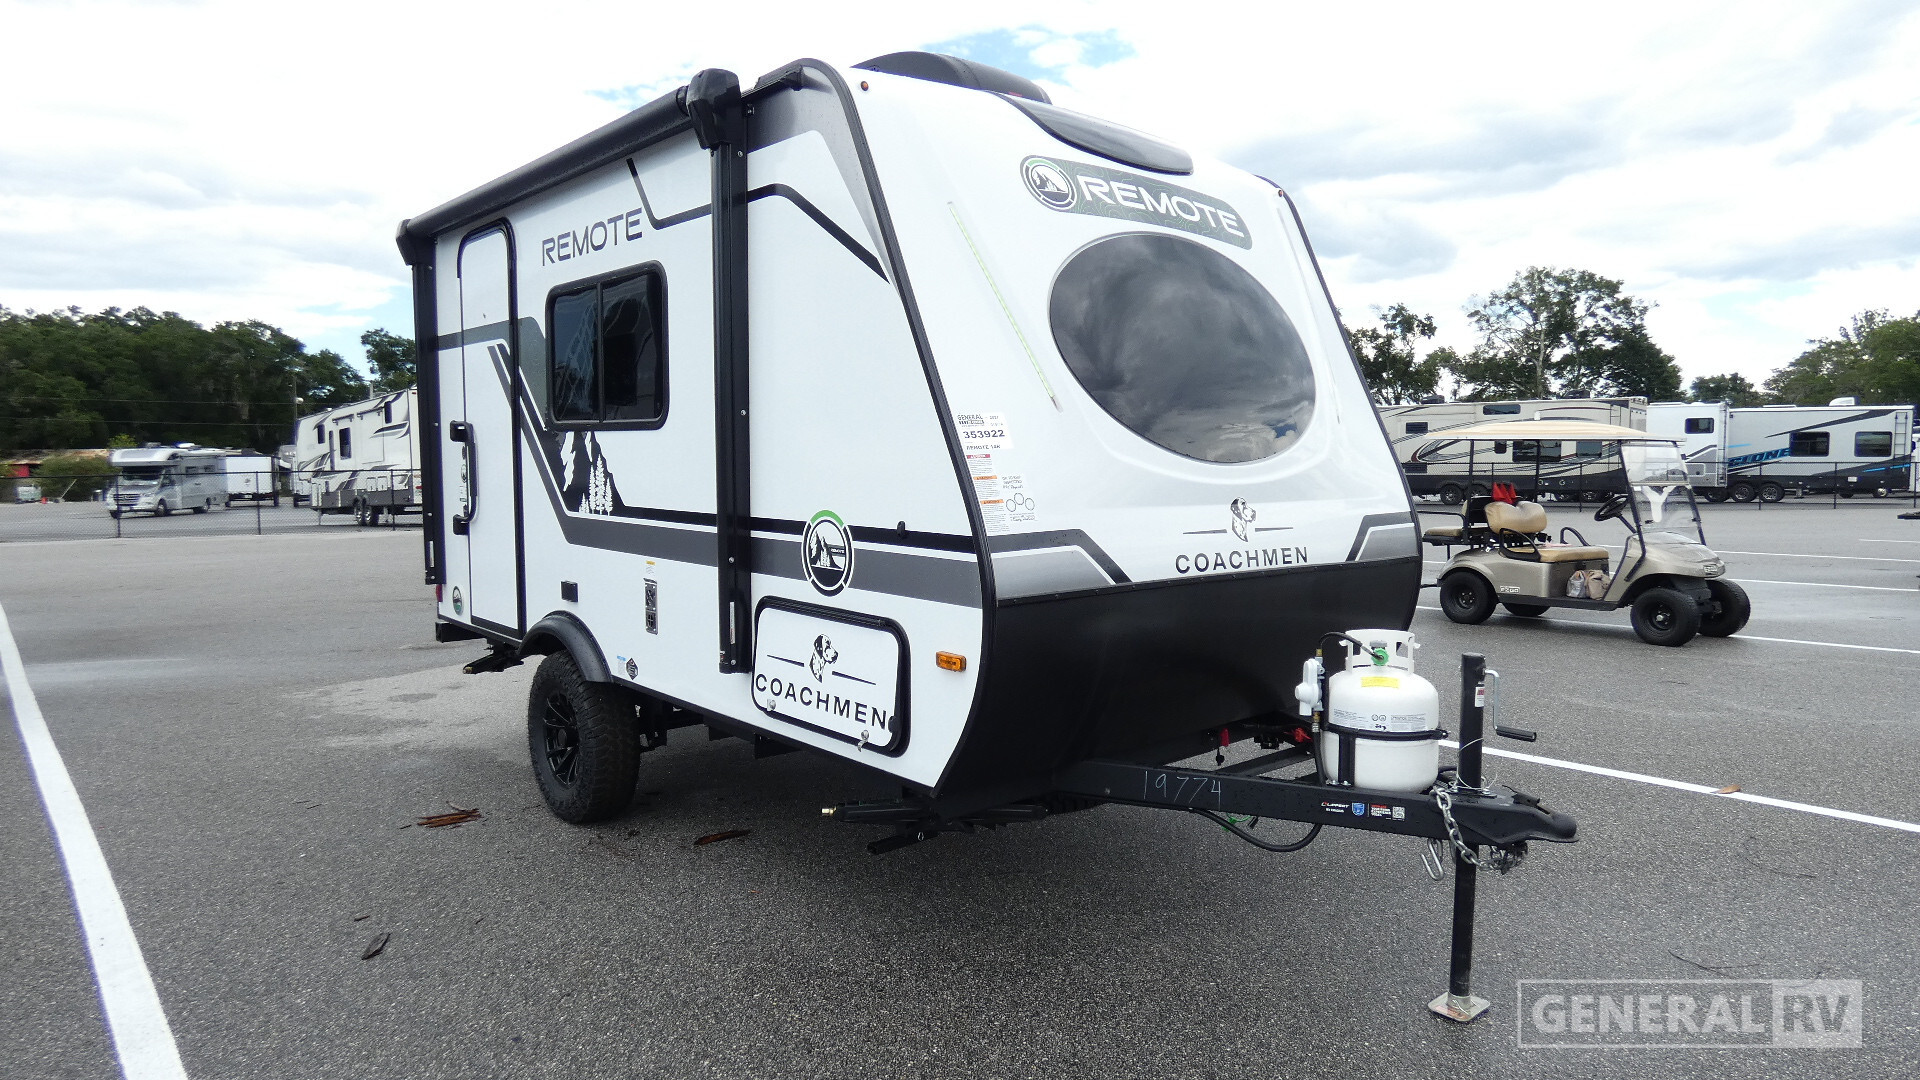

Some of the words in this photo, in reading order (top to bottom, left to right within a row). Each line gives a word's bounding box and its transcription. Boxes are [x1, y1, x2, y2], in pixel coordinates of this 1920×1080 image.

[1076, 174, 1245, 238] REMOTE
[541, 207, 643, 267] REMOTE
[962, 429, 1006, 439] 353922
[1175, 546, 1308, 574] COACHMEN
[755, 673, 887, 730] COACHMEN
[1143, 770, 1221, 812] 19774
